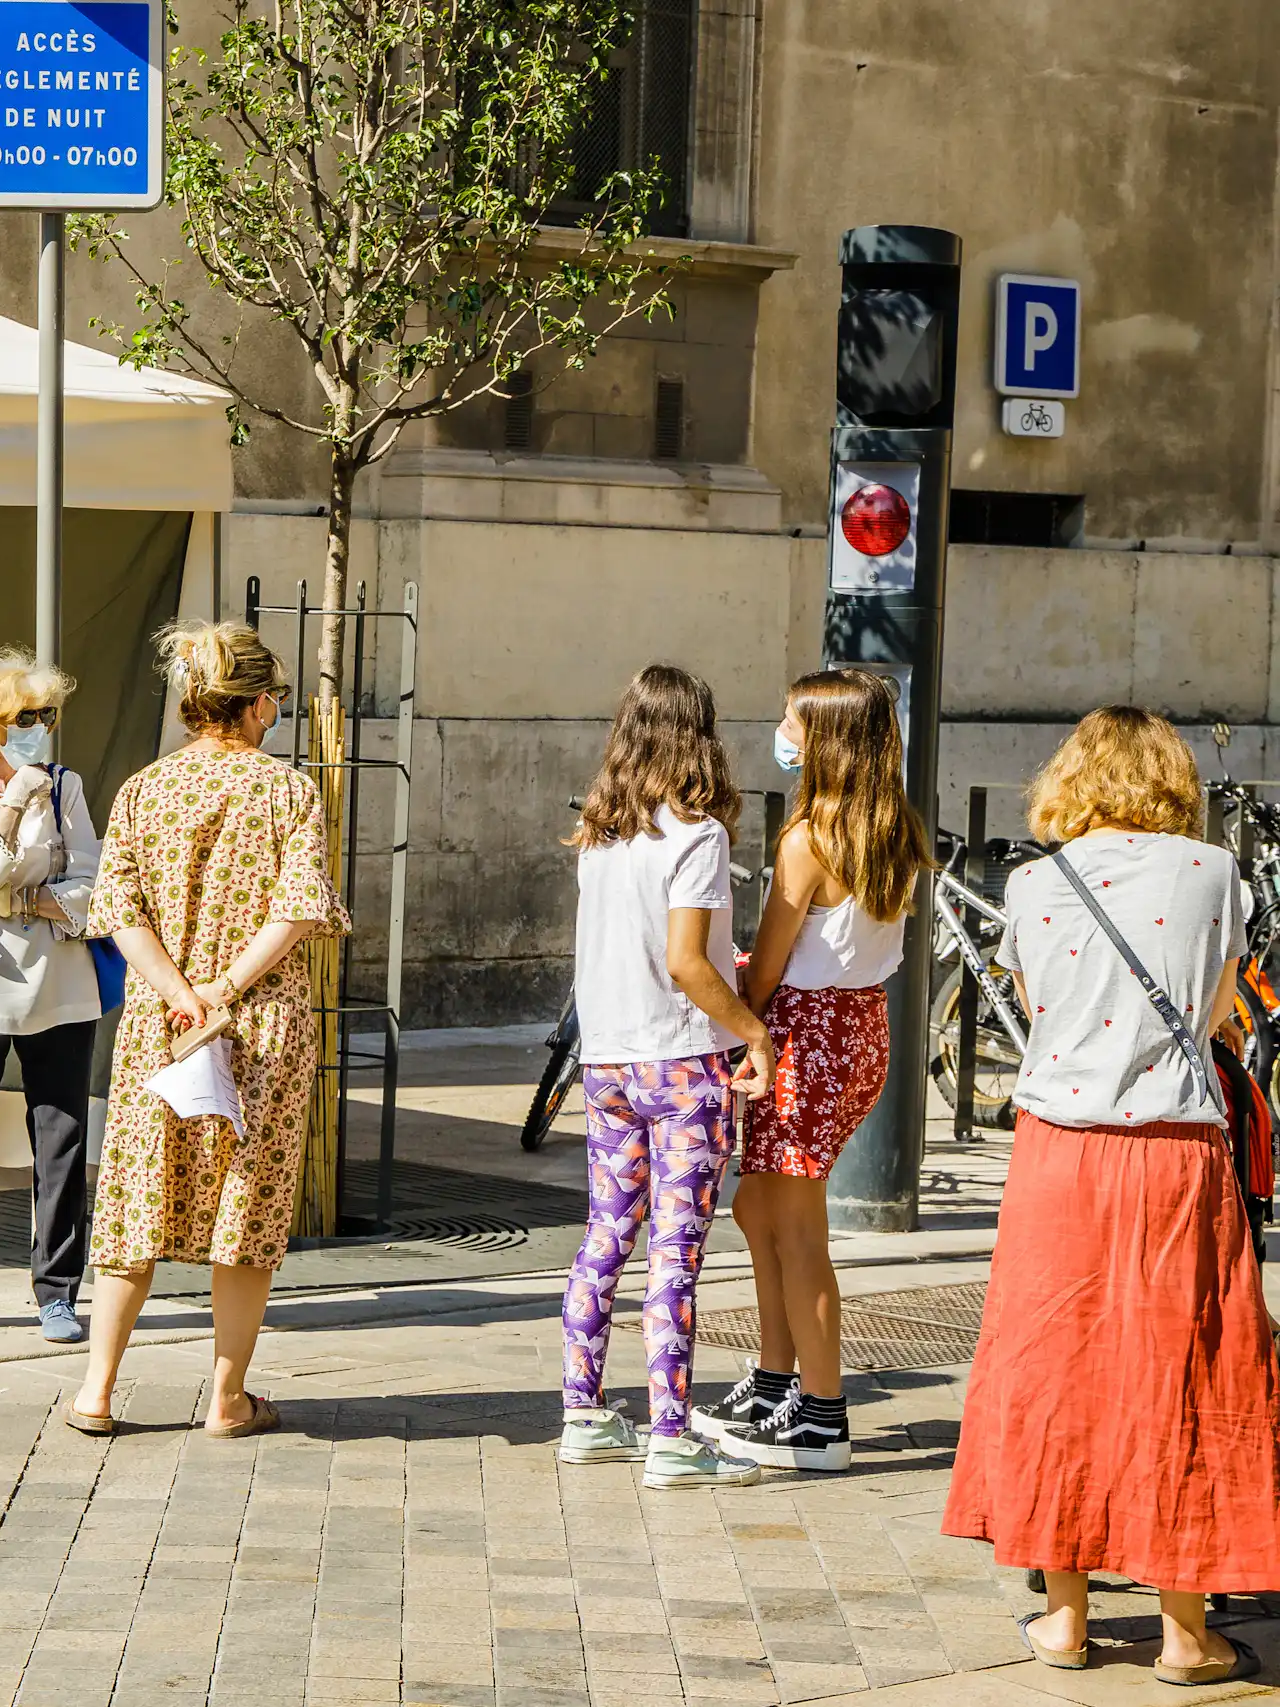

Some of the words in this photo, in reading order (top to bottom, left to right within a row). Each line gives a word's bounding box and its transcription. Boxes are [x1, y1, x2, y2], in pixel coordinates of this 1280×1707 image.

[17, 29, 96, 52] ACCÈS
[6, 108, 35, 127] DE
[48, 108, 106, 128] NUIT
[67, 146, 137, 166] 07h00
[1024, 301, 1058, 371] P
